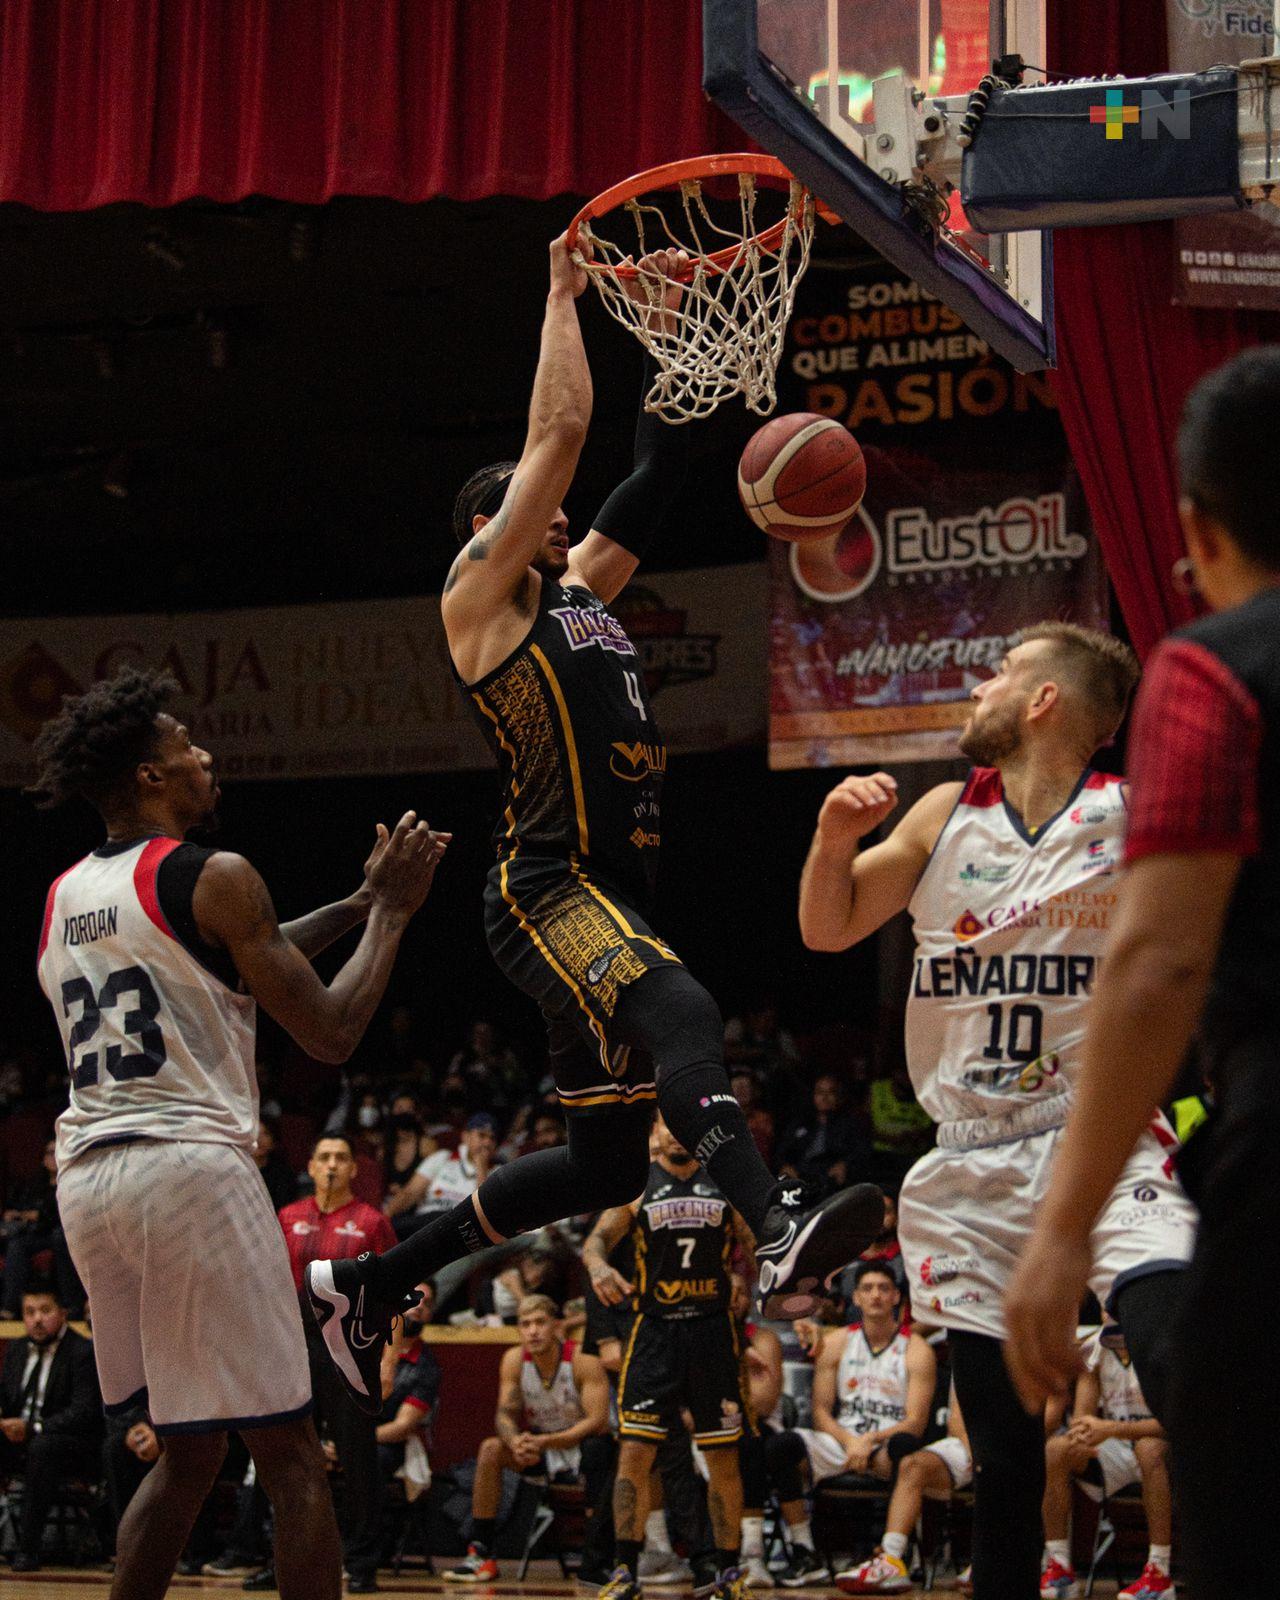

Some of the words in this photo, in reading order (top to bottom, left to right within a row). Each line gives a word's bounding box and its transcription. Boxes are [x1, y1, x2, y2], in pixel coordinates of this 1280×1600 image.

[791, 347, 860, 380] QUE
[623, 670, 648, 721] 4
[61, 965, 167, 1089] 23
[982, 1003, 1042, 1061] 10
[676, 1237, 696, 1269] 7
